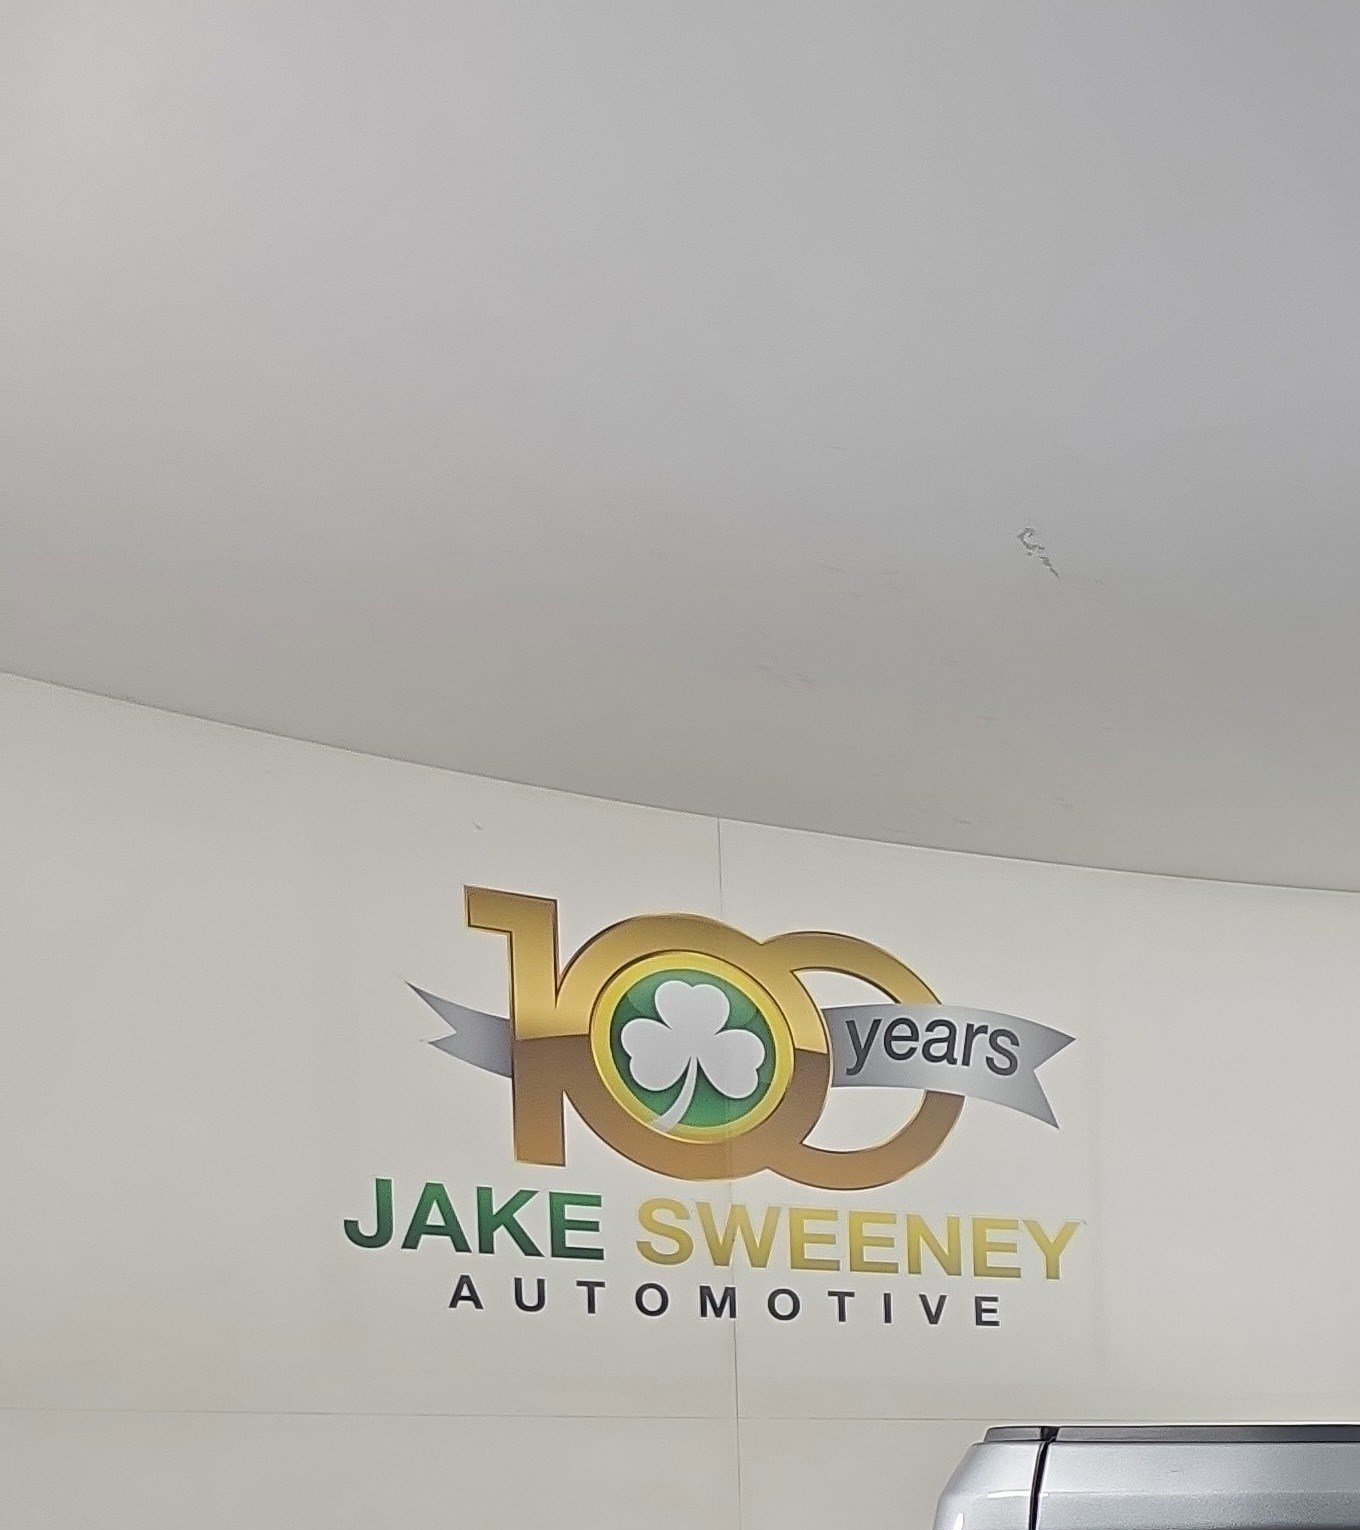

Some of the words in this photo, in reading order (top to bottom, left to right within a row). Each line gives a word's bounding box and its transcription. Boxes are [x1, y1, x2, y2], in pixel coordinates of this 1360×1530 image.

[844, 1012, 1021, 1077] years
[343, 1177, 604, 1261] JAKE
[635, 1197, 1081, 1281] SWEENEY
[448, 1274, 1001, 1327] AUTOMOTIVE
